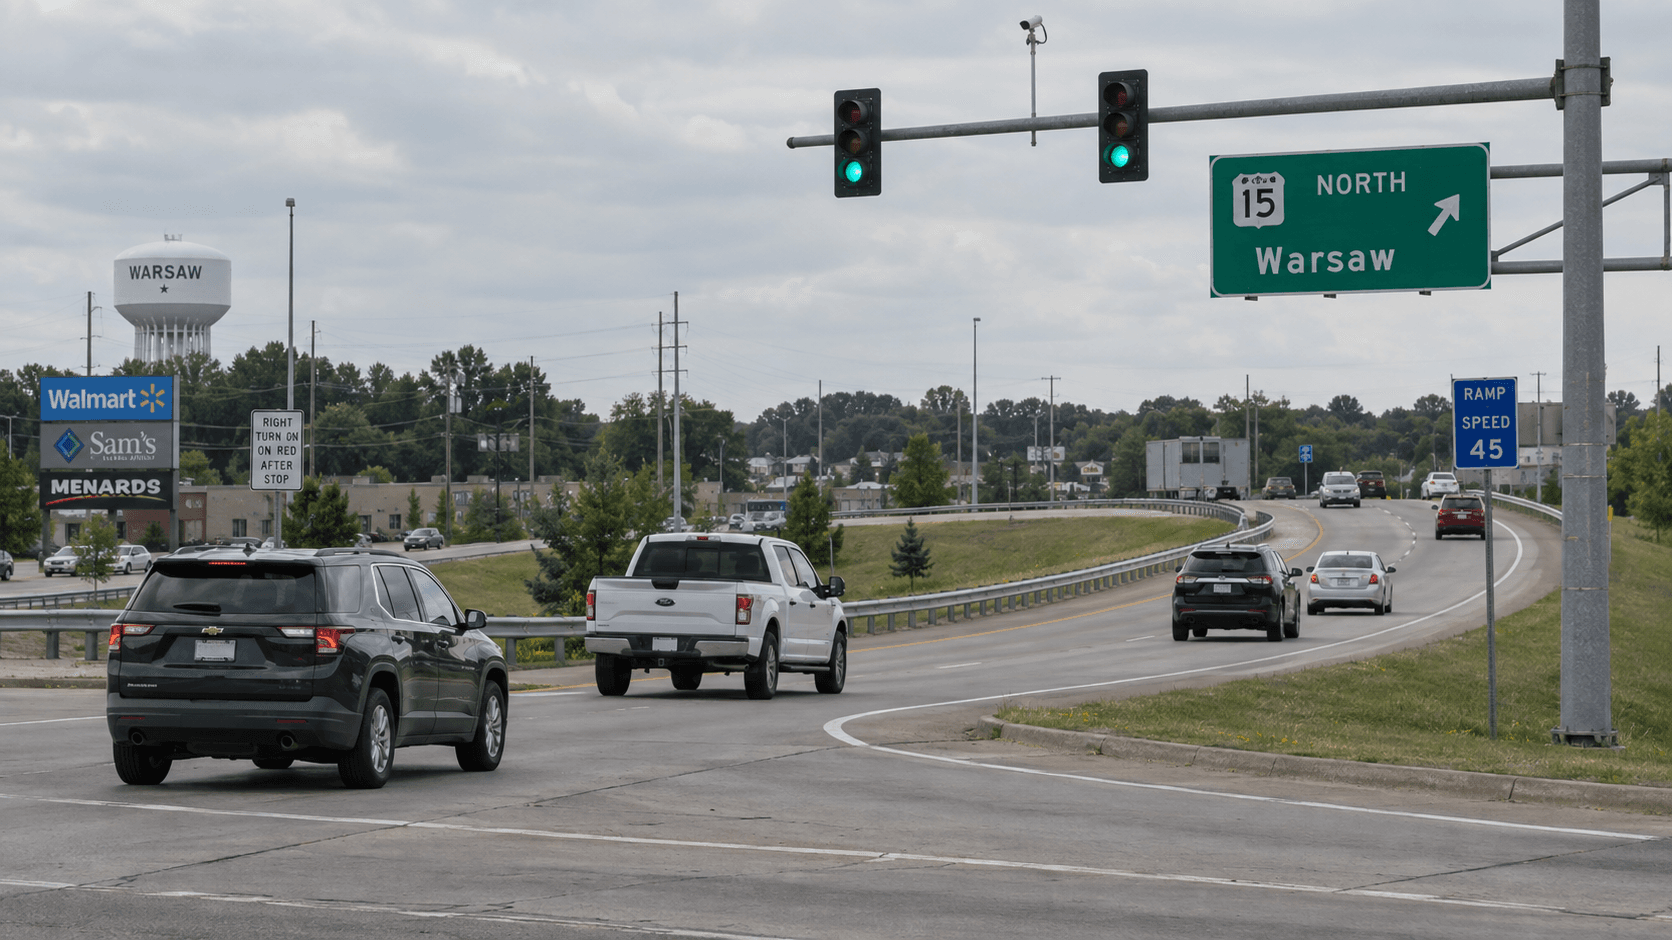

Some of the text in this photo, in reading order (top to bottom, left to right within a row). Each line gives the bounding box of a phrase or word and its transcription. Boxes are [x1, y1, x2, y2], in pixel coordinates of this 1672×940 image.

[1317, 171, 1406, 195] NORTH
[1242, 188, 1276, 218] 15
[1255, 246, 1395, 275] Warsaw
[129, 265, 203, 280] WARSAW
[48, 388, 137, 409] Walmart
[1464, 386, 1506, 400] RAMP
[262, 417, 293, 427] RIGHT
[1462, 415, 1510, 430] SPEED
[90, 431, 156, 455] Sam's
[256, 431, 299, 441] TURN ON
[257, 445, 297, 455] ON RED
[1469, 438, 1503, 460] 45
[260, 460, 293, 470] AFTER
[51, 478, 161, 495] MENARDS
[264, 474, 289, 484] STOP
